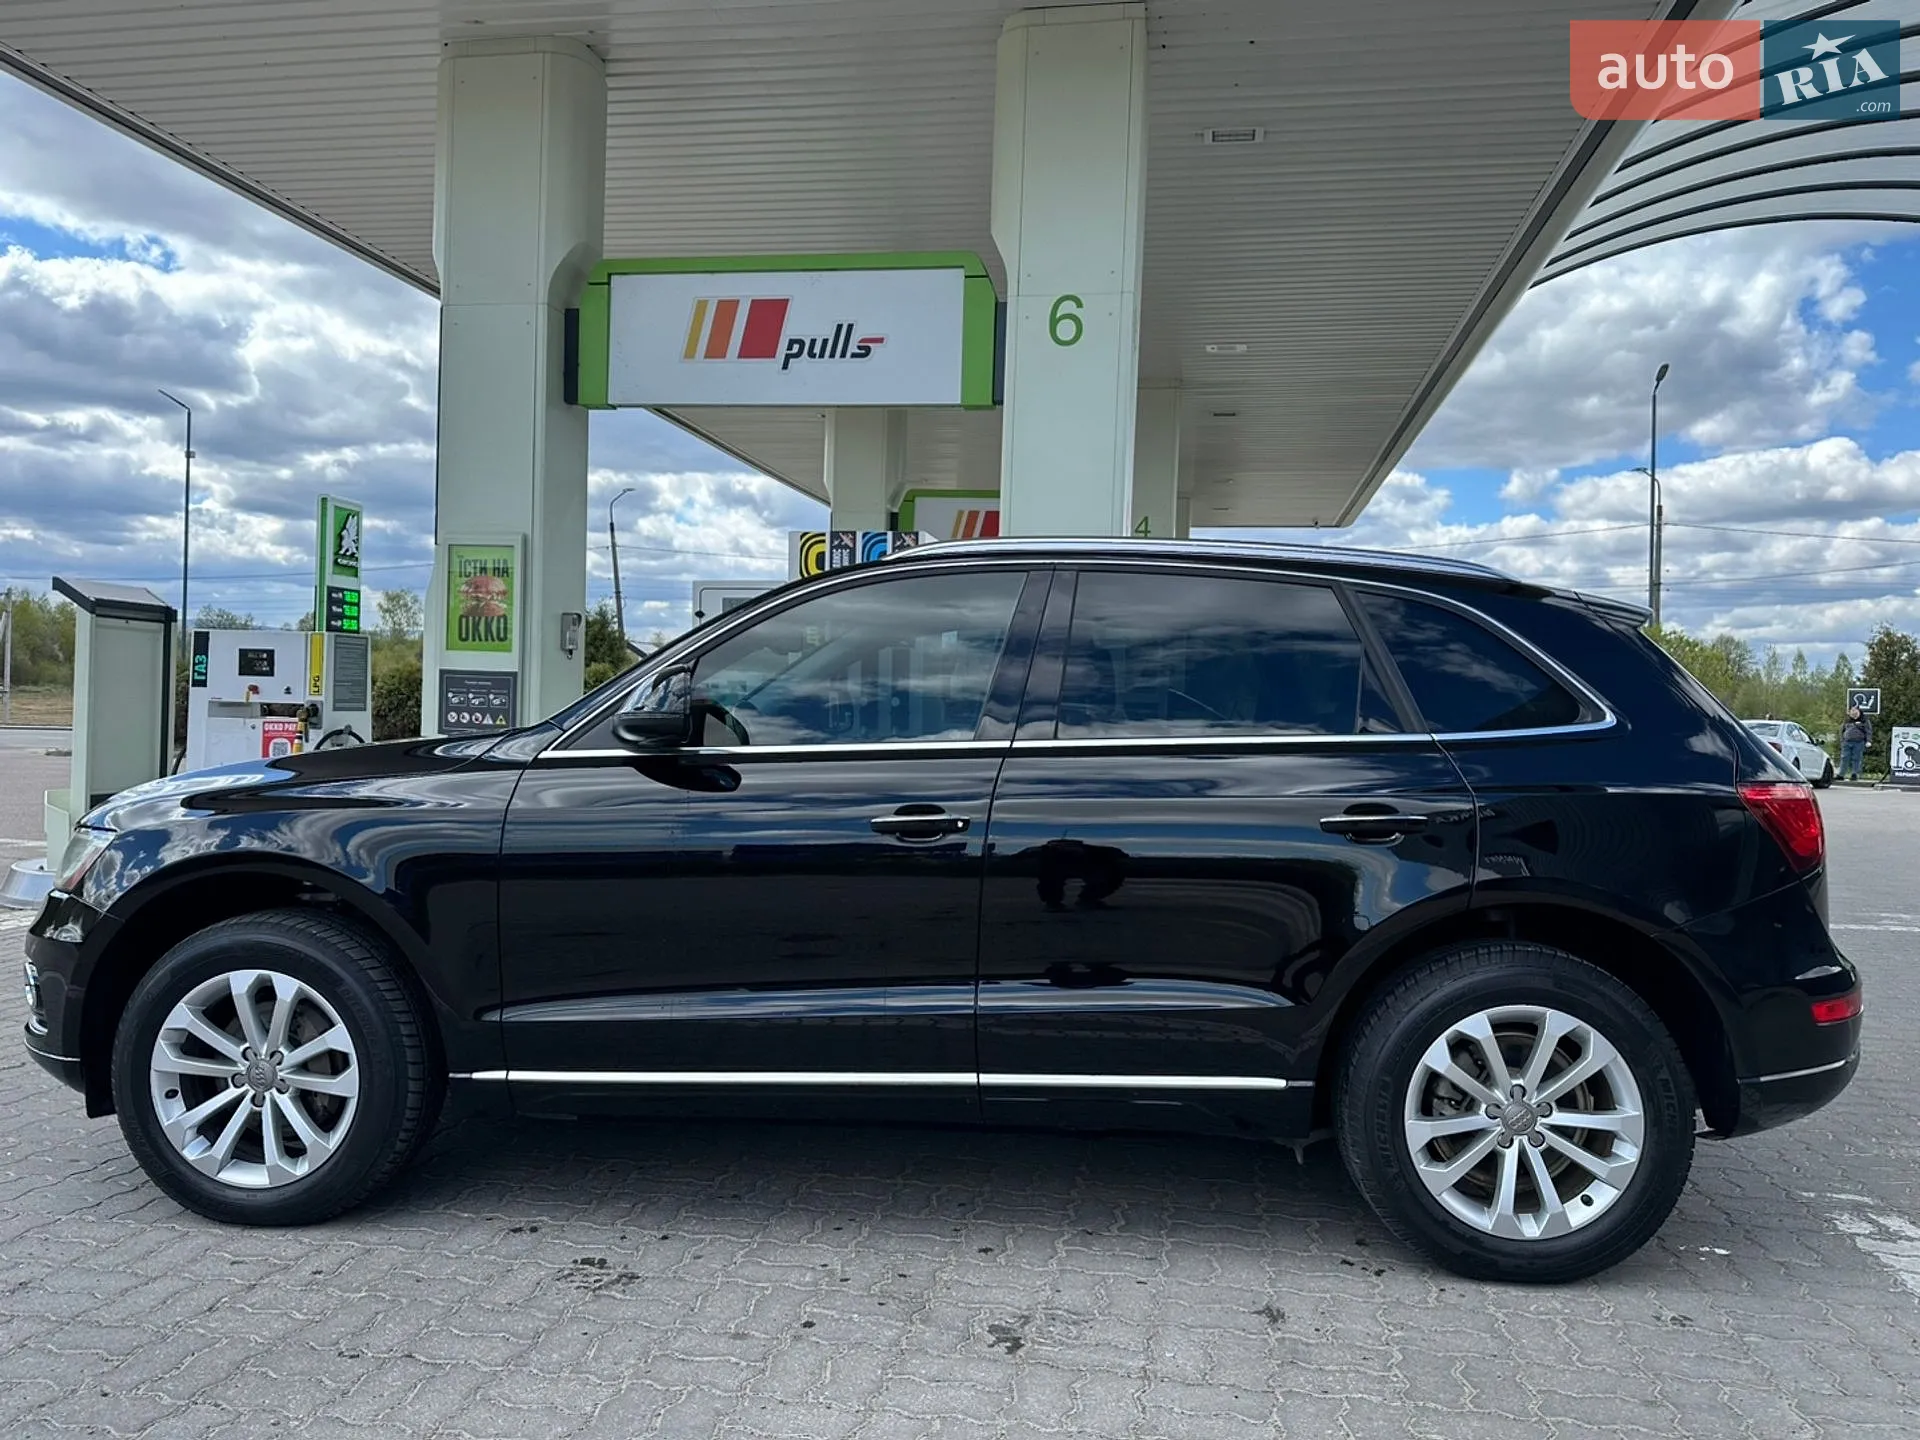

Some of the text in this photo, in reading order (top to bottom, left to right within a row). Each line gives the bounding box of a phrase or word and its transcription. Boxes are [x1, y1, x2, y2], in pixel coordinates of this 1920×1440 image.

[1049, 294, 1084, 347] 6
[781, 323, 886, 370] pulls
[1134, 516, 1151, 538] 4
[492, 559, 510, 577] НА
[194, 654, 206, 680] ГАЗ
[312, 675, 320, 693] LPG
